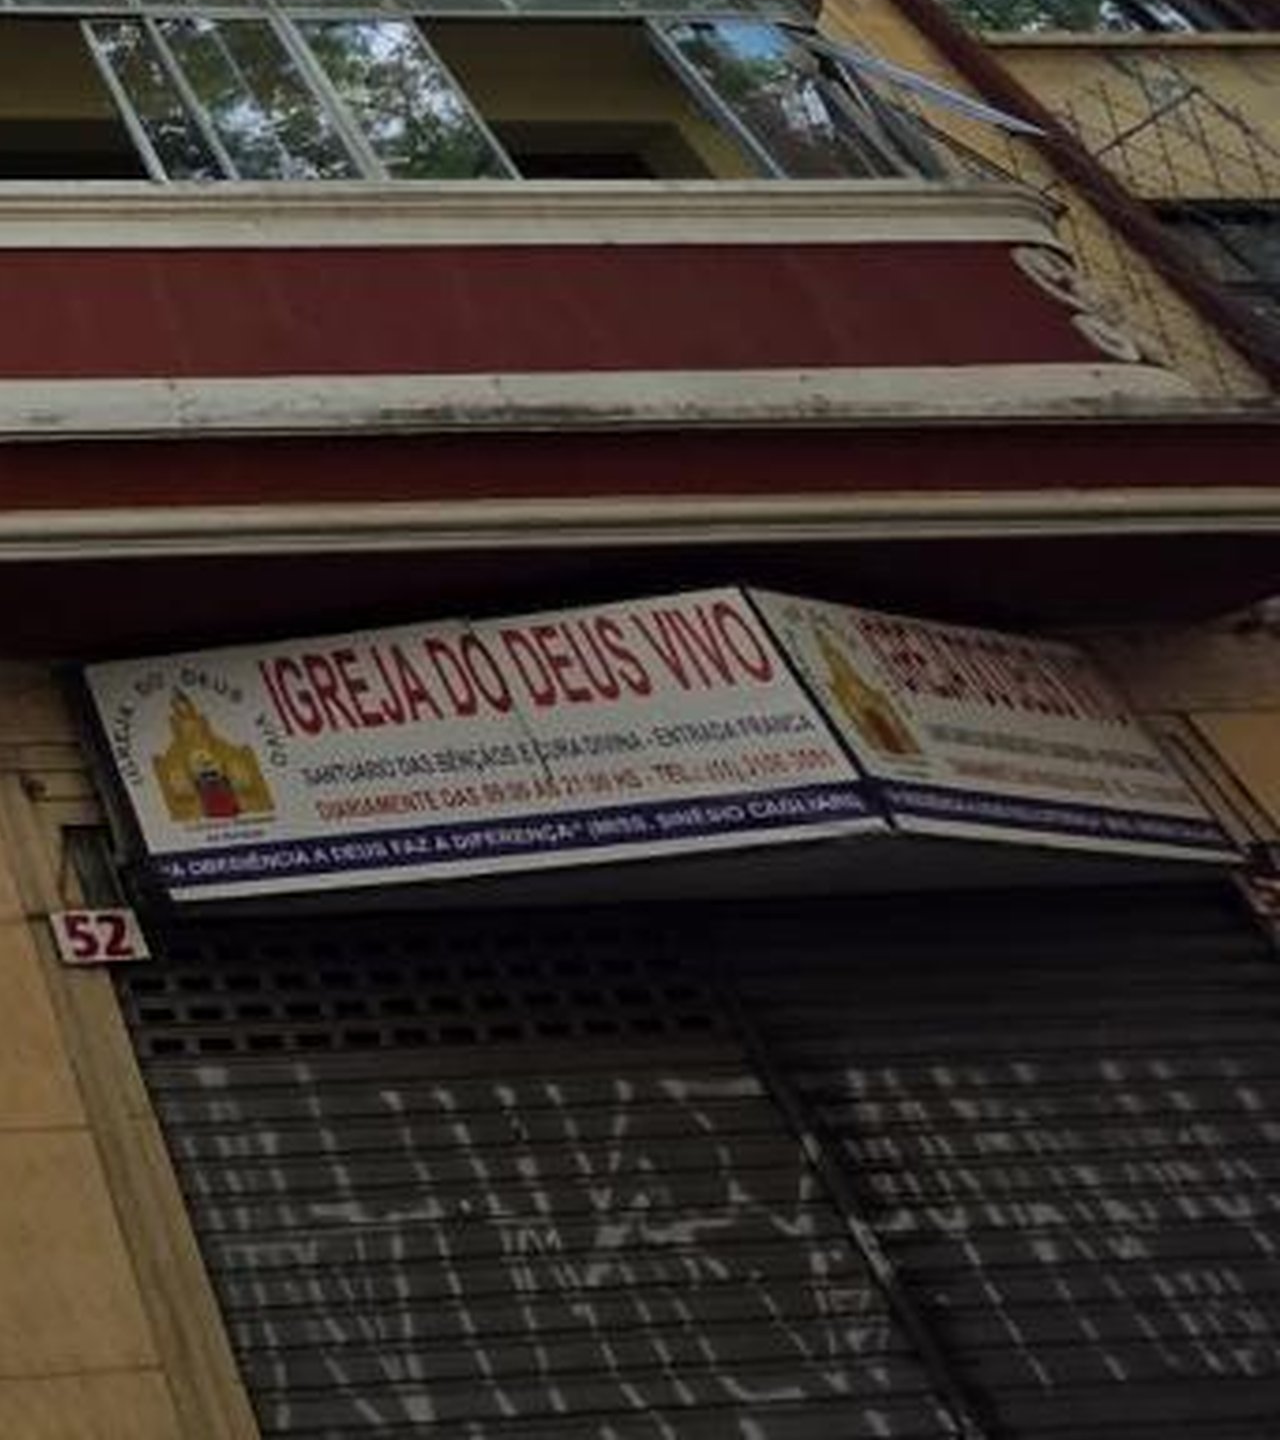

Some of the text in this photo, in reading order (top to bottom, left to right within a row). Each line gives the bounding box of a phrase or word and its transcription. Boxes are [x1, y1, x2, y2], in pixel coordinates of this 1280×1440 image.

[260, 641, 444, 737] IGREJA
[424, 631, 512, 717] DO
[500, 613, 651, 707] DEUS
[633, 600, 774, 690] VIVO
[648, 718, 740, 746] ENTRADA
[327, 839, 392, 864] DEUS
[65, 914, 134, 957] 52
